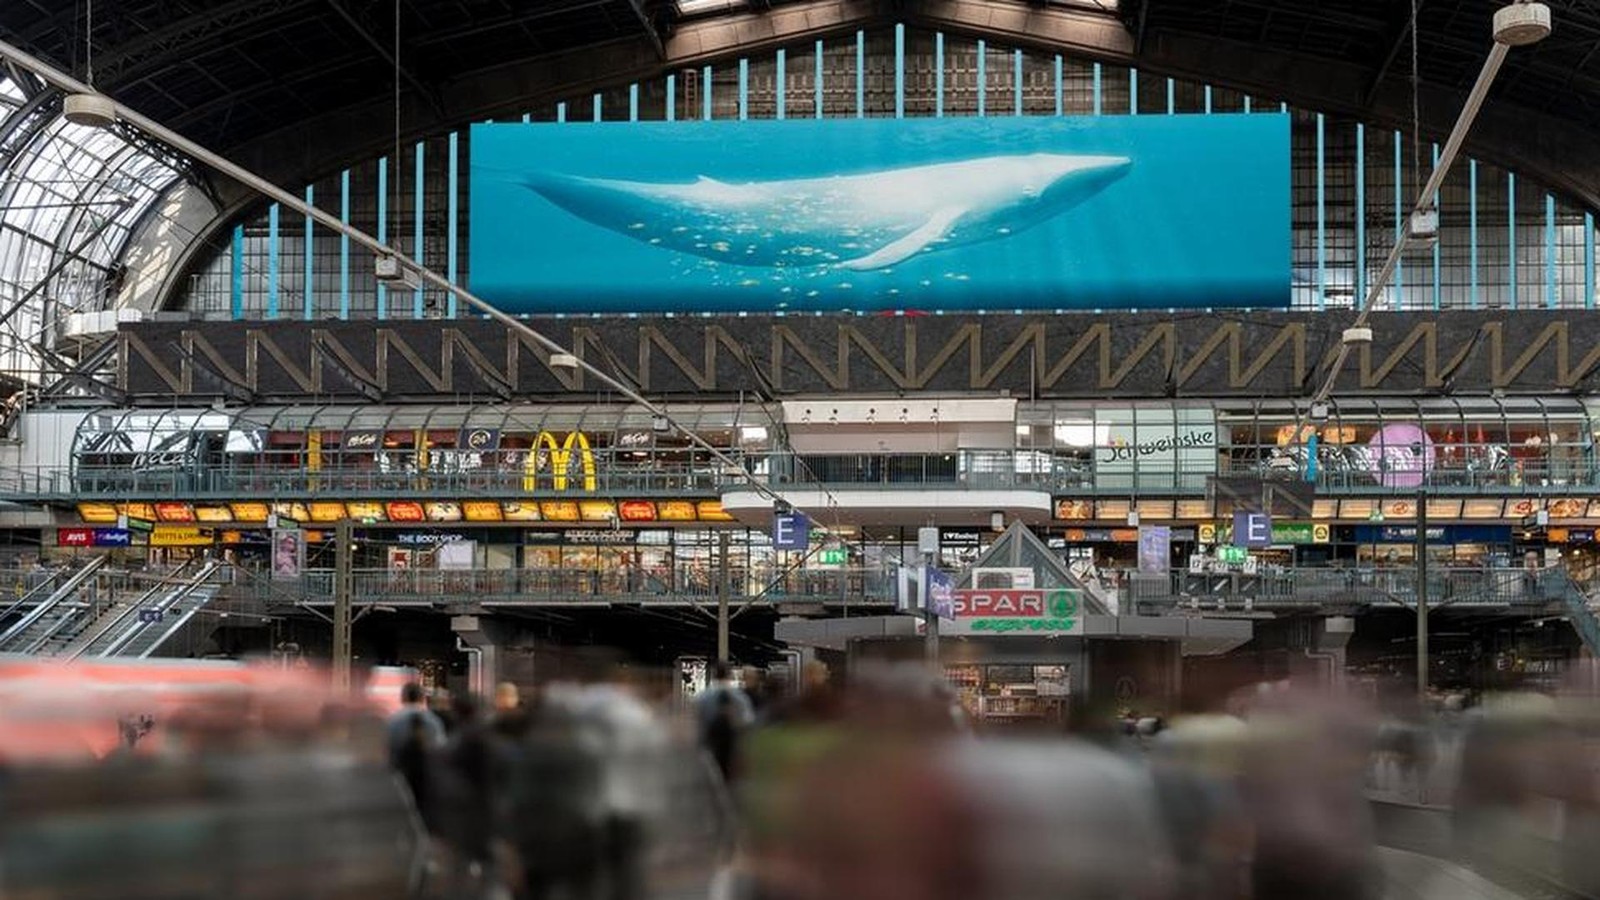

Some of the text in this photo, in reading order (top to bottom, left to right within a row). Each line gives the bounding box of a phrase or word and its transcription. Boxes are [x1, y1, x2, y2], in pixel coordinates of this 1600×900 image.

[398, 534, 415, 543] THE
[416, 534, 439, 543] BODY
[777, 517, 795, 544] E
[1248, 514, 1266, 541] E
[954, 595, 1042, 613] SPAR
